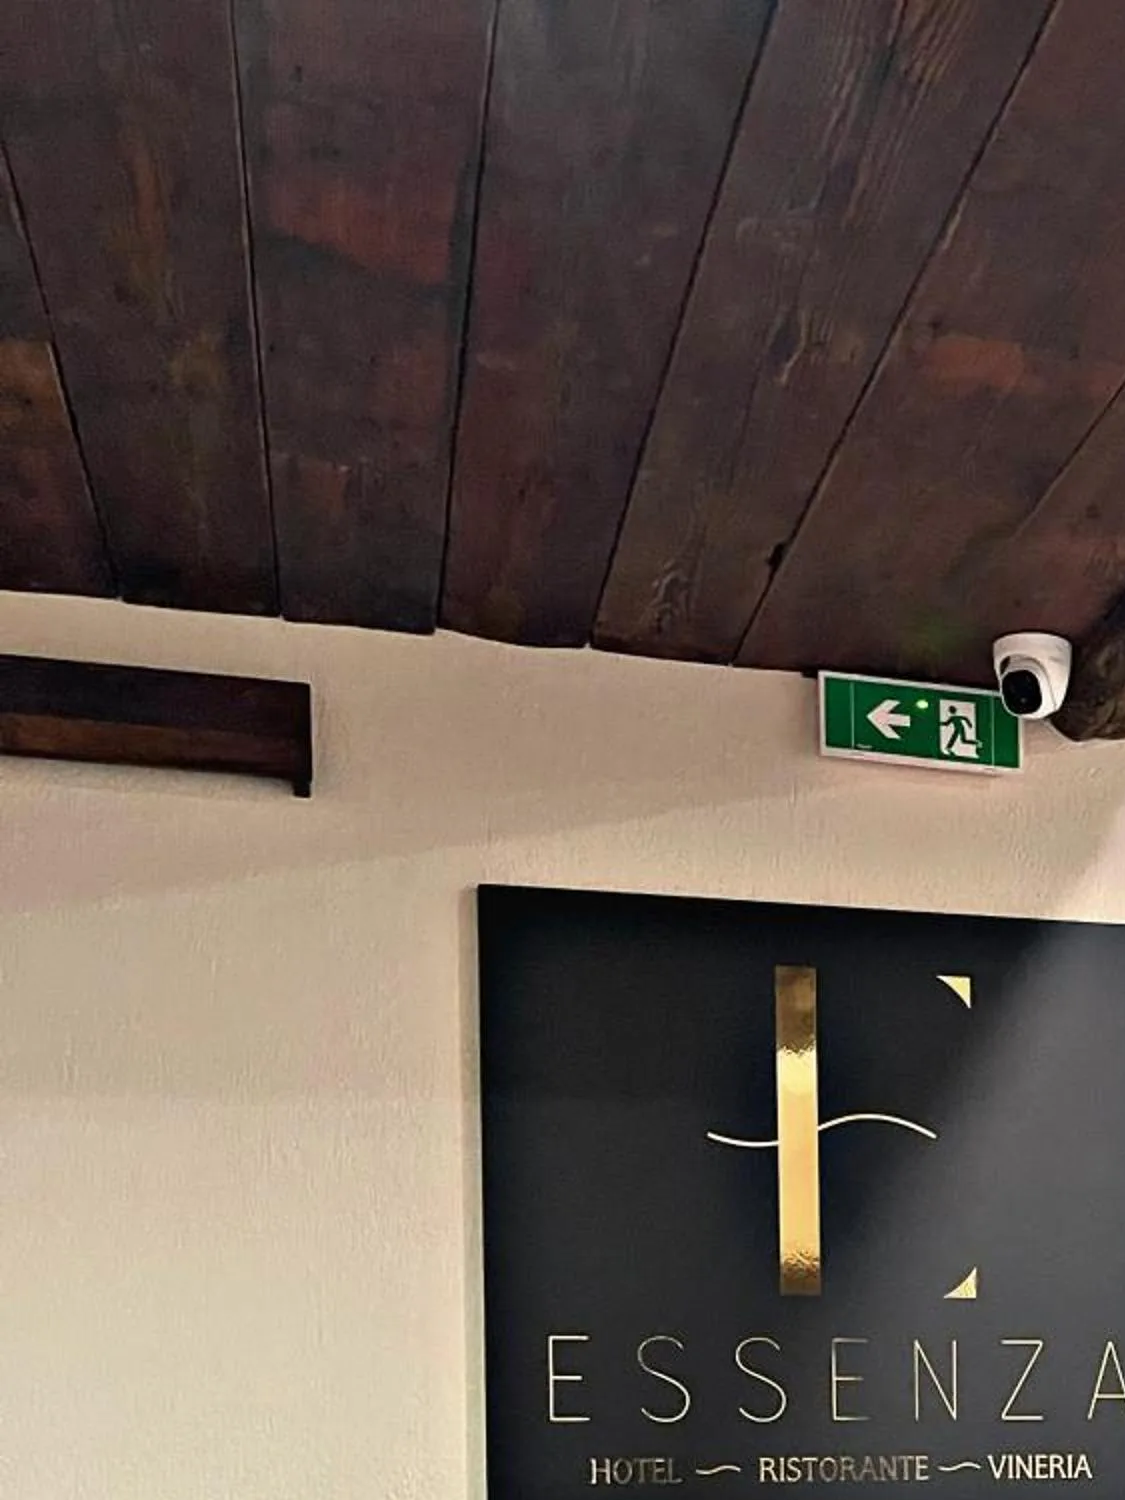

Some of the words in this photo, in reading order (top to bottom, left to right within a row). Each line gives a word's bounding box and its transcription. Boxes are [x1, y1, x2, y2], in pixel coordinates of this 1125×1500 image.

[590, 1457, 683, 1486] HOTEL
[759, 1455, 930, 1484] RISTORANTE
[987, 1453, 1093, 1481] VINERIA
